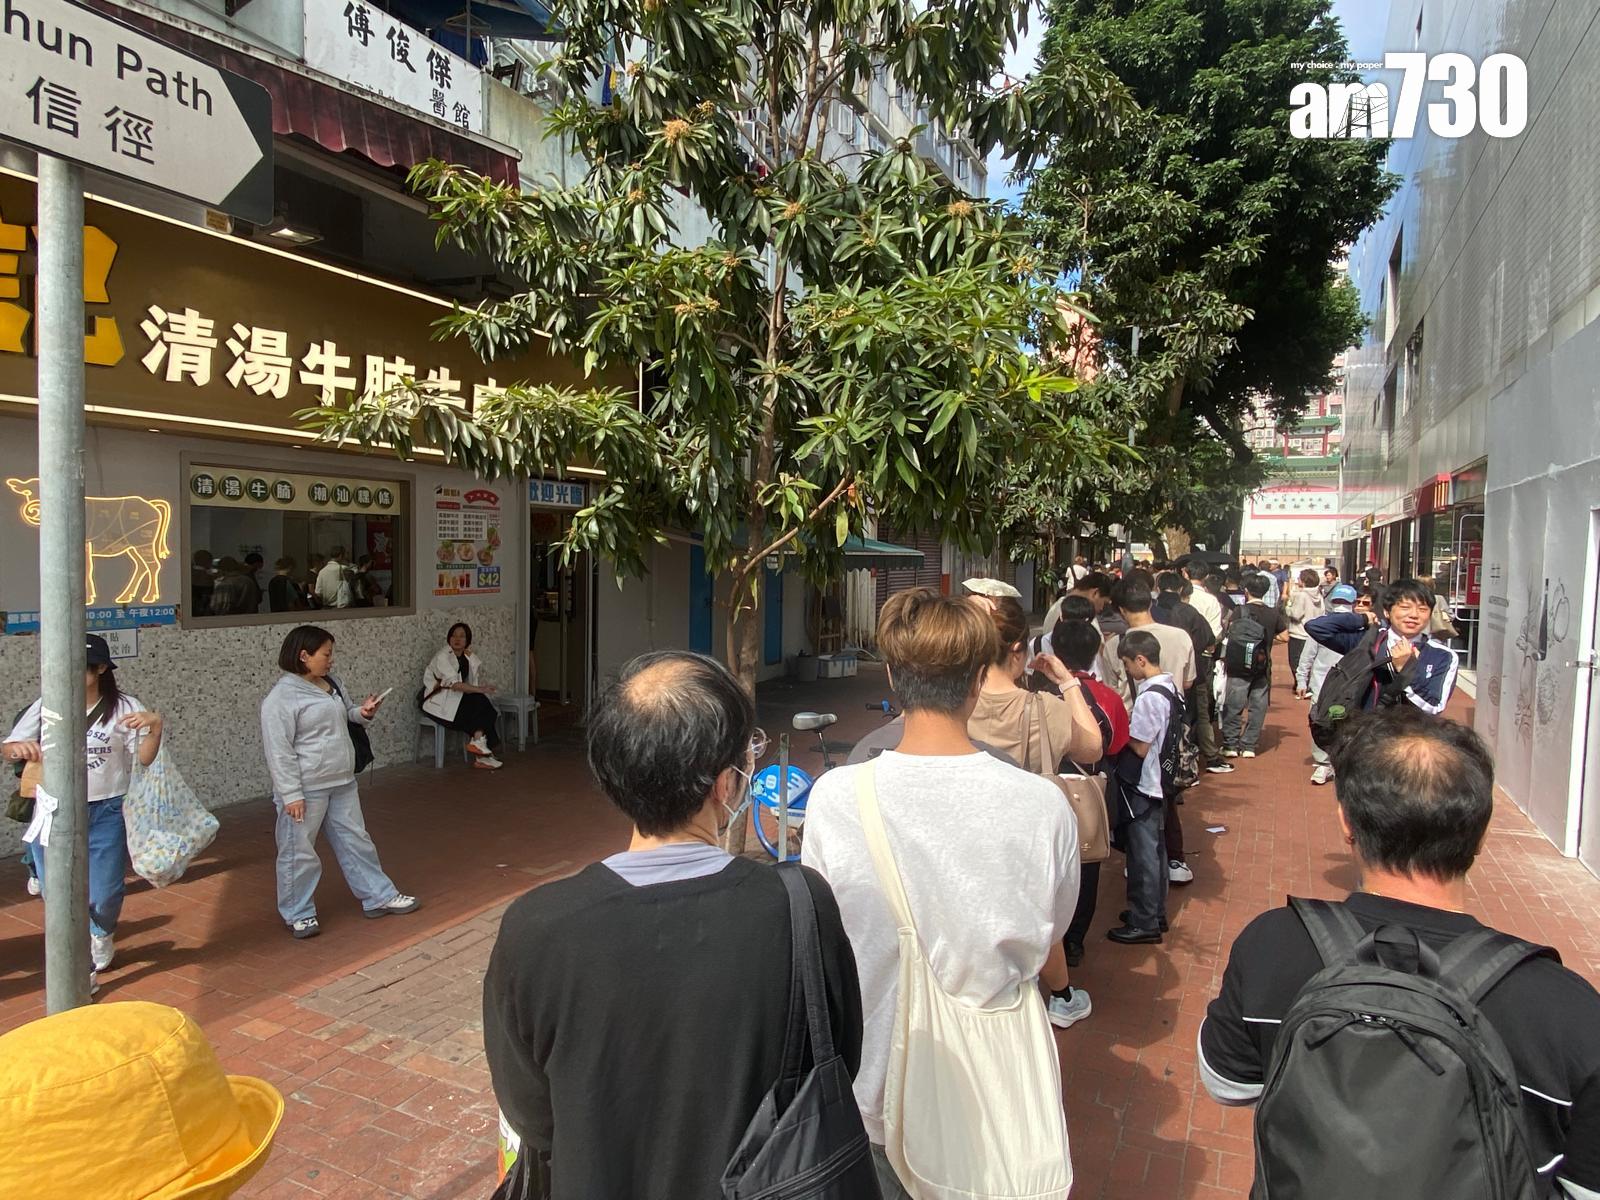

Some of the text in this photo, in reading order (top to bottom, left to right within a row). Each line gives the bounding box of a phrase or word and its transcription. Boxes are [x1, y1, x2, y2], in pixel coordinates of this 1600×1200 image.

[343, 0, 452, 89] 傅俊傑
[117, 43, 213, 116] Path
[25, 76, 155, 165] 信徑
[430, 88, 470, 130] 醫館
[197, 477, 291, 500] 清湯牛腩
[478, 572, 500, 586] $42
[94, 731, 111, 744] SEA
